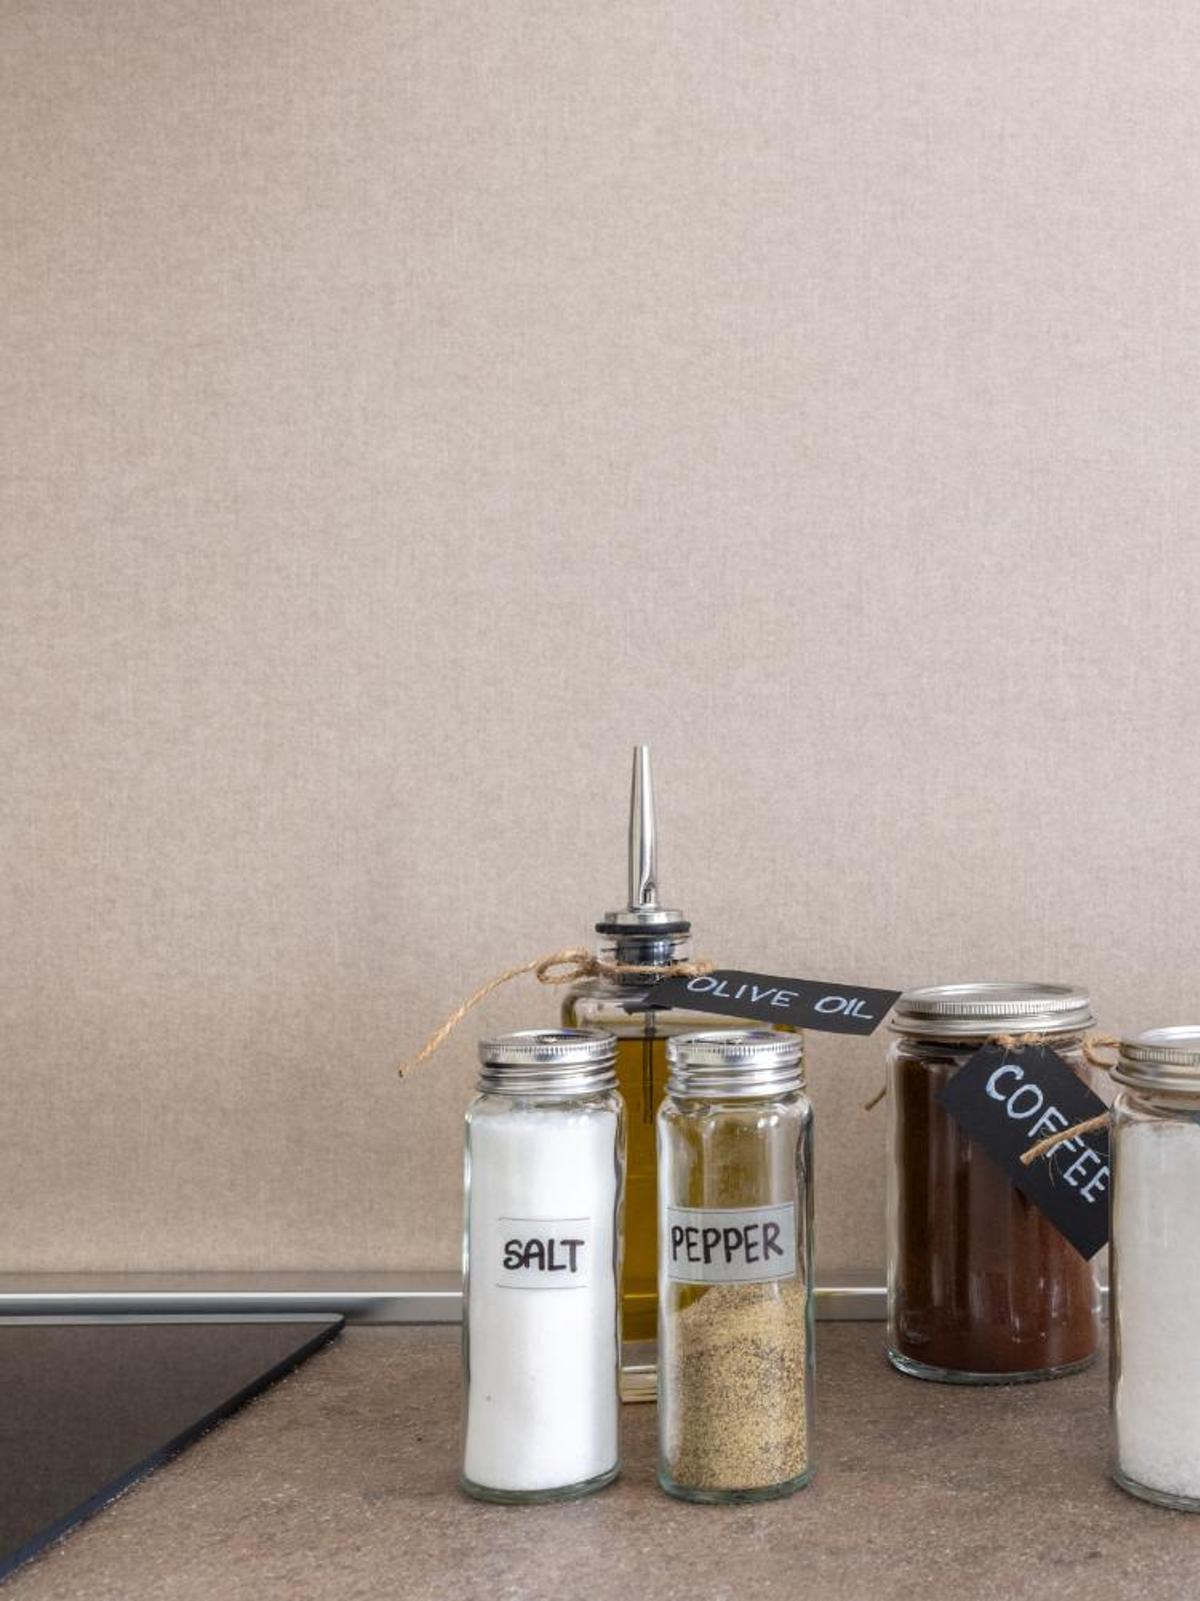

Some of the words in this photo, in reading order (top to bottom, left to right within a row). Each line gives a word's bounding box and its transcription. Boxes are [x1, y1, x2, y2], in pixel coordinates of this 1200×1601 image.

[687, 976, 798, 1007] OLIVE
[814, 995, 875, 1020] OIL
[986, 1064, 1110, 1203] COFFEE
[503, 1239, 585, 1273] SALT
[671, 1222, 784, 1265] PEPPER
